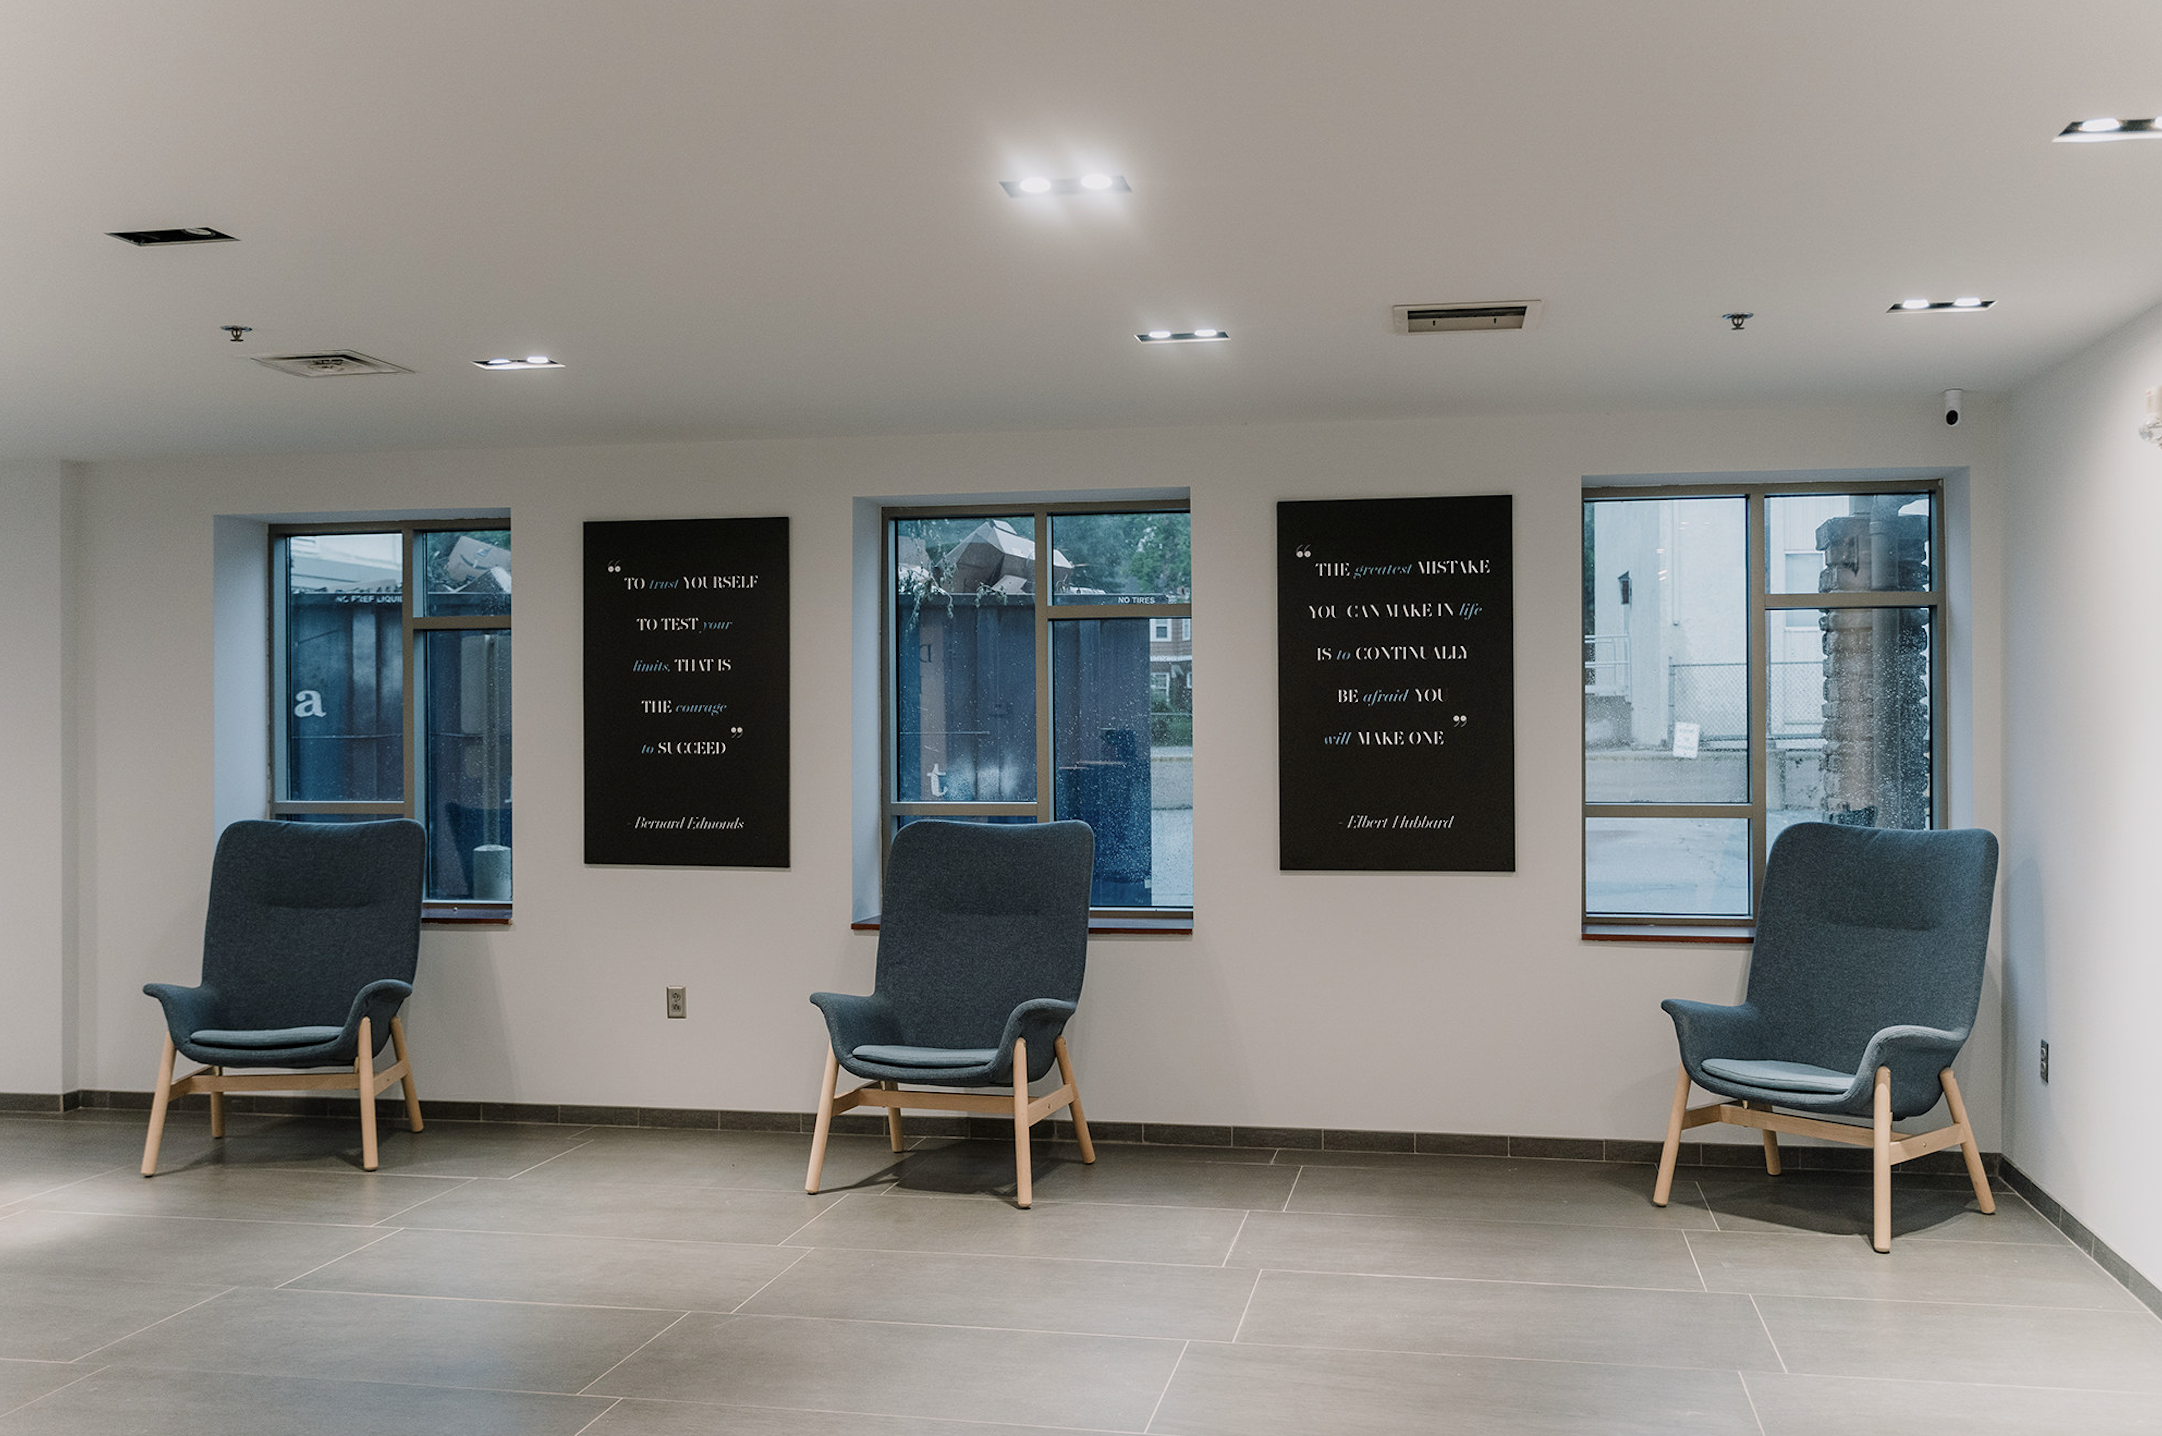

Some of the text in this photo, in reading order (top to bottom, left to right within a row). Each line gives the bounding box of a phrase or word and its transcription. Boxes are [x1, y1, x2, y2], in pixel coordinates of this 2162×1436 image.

[1315, 562, 1351, 577] THE
[1353, 563, 1413, 580] greatest
[1418, 559, 1491, 575] MISTAKE
[649, 579, 679, 589] trust
[683, 575, 760, 589] YOURSELF
[1118, 596, 1156, 604] NO TIRES
[1308, 602, 1483, 620] YOU CAN MAKE IN life
[636, 617, 733, 634] TO TEST your
[1317, 645, 1470, 661] IS to CONTINUALLY
[674, 659, 714, 672] THAT
[718, 659, 732, 672] IS
[294, 689, 327, 719] a
[1338, 687, 1448, 707] BE afraid YOU
[641, 700, 728, 717] THE courage
[1324, 731, 1352, 745] will
[1358, 731, 1405, 746] MAKE
[1409, 731, 1445, 746] ONE
[641, 743, 655, 755] to
[657, 741, 727, 755] SUCCEED
[927, 763, 948, 797] t
[634, 816, 686, 830] Bernard
[687, 816, 745, 830] Edmonds
[1347, 815, 1388, 829] Elbert
[1391, 815, 1456, 829] Hubbard
